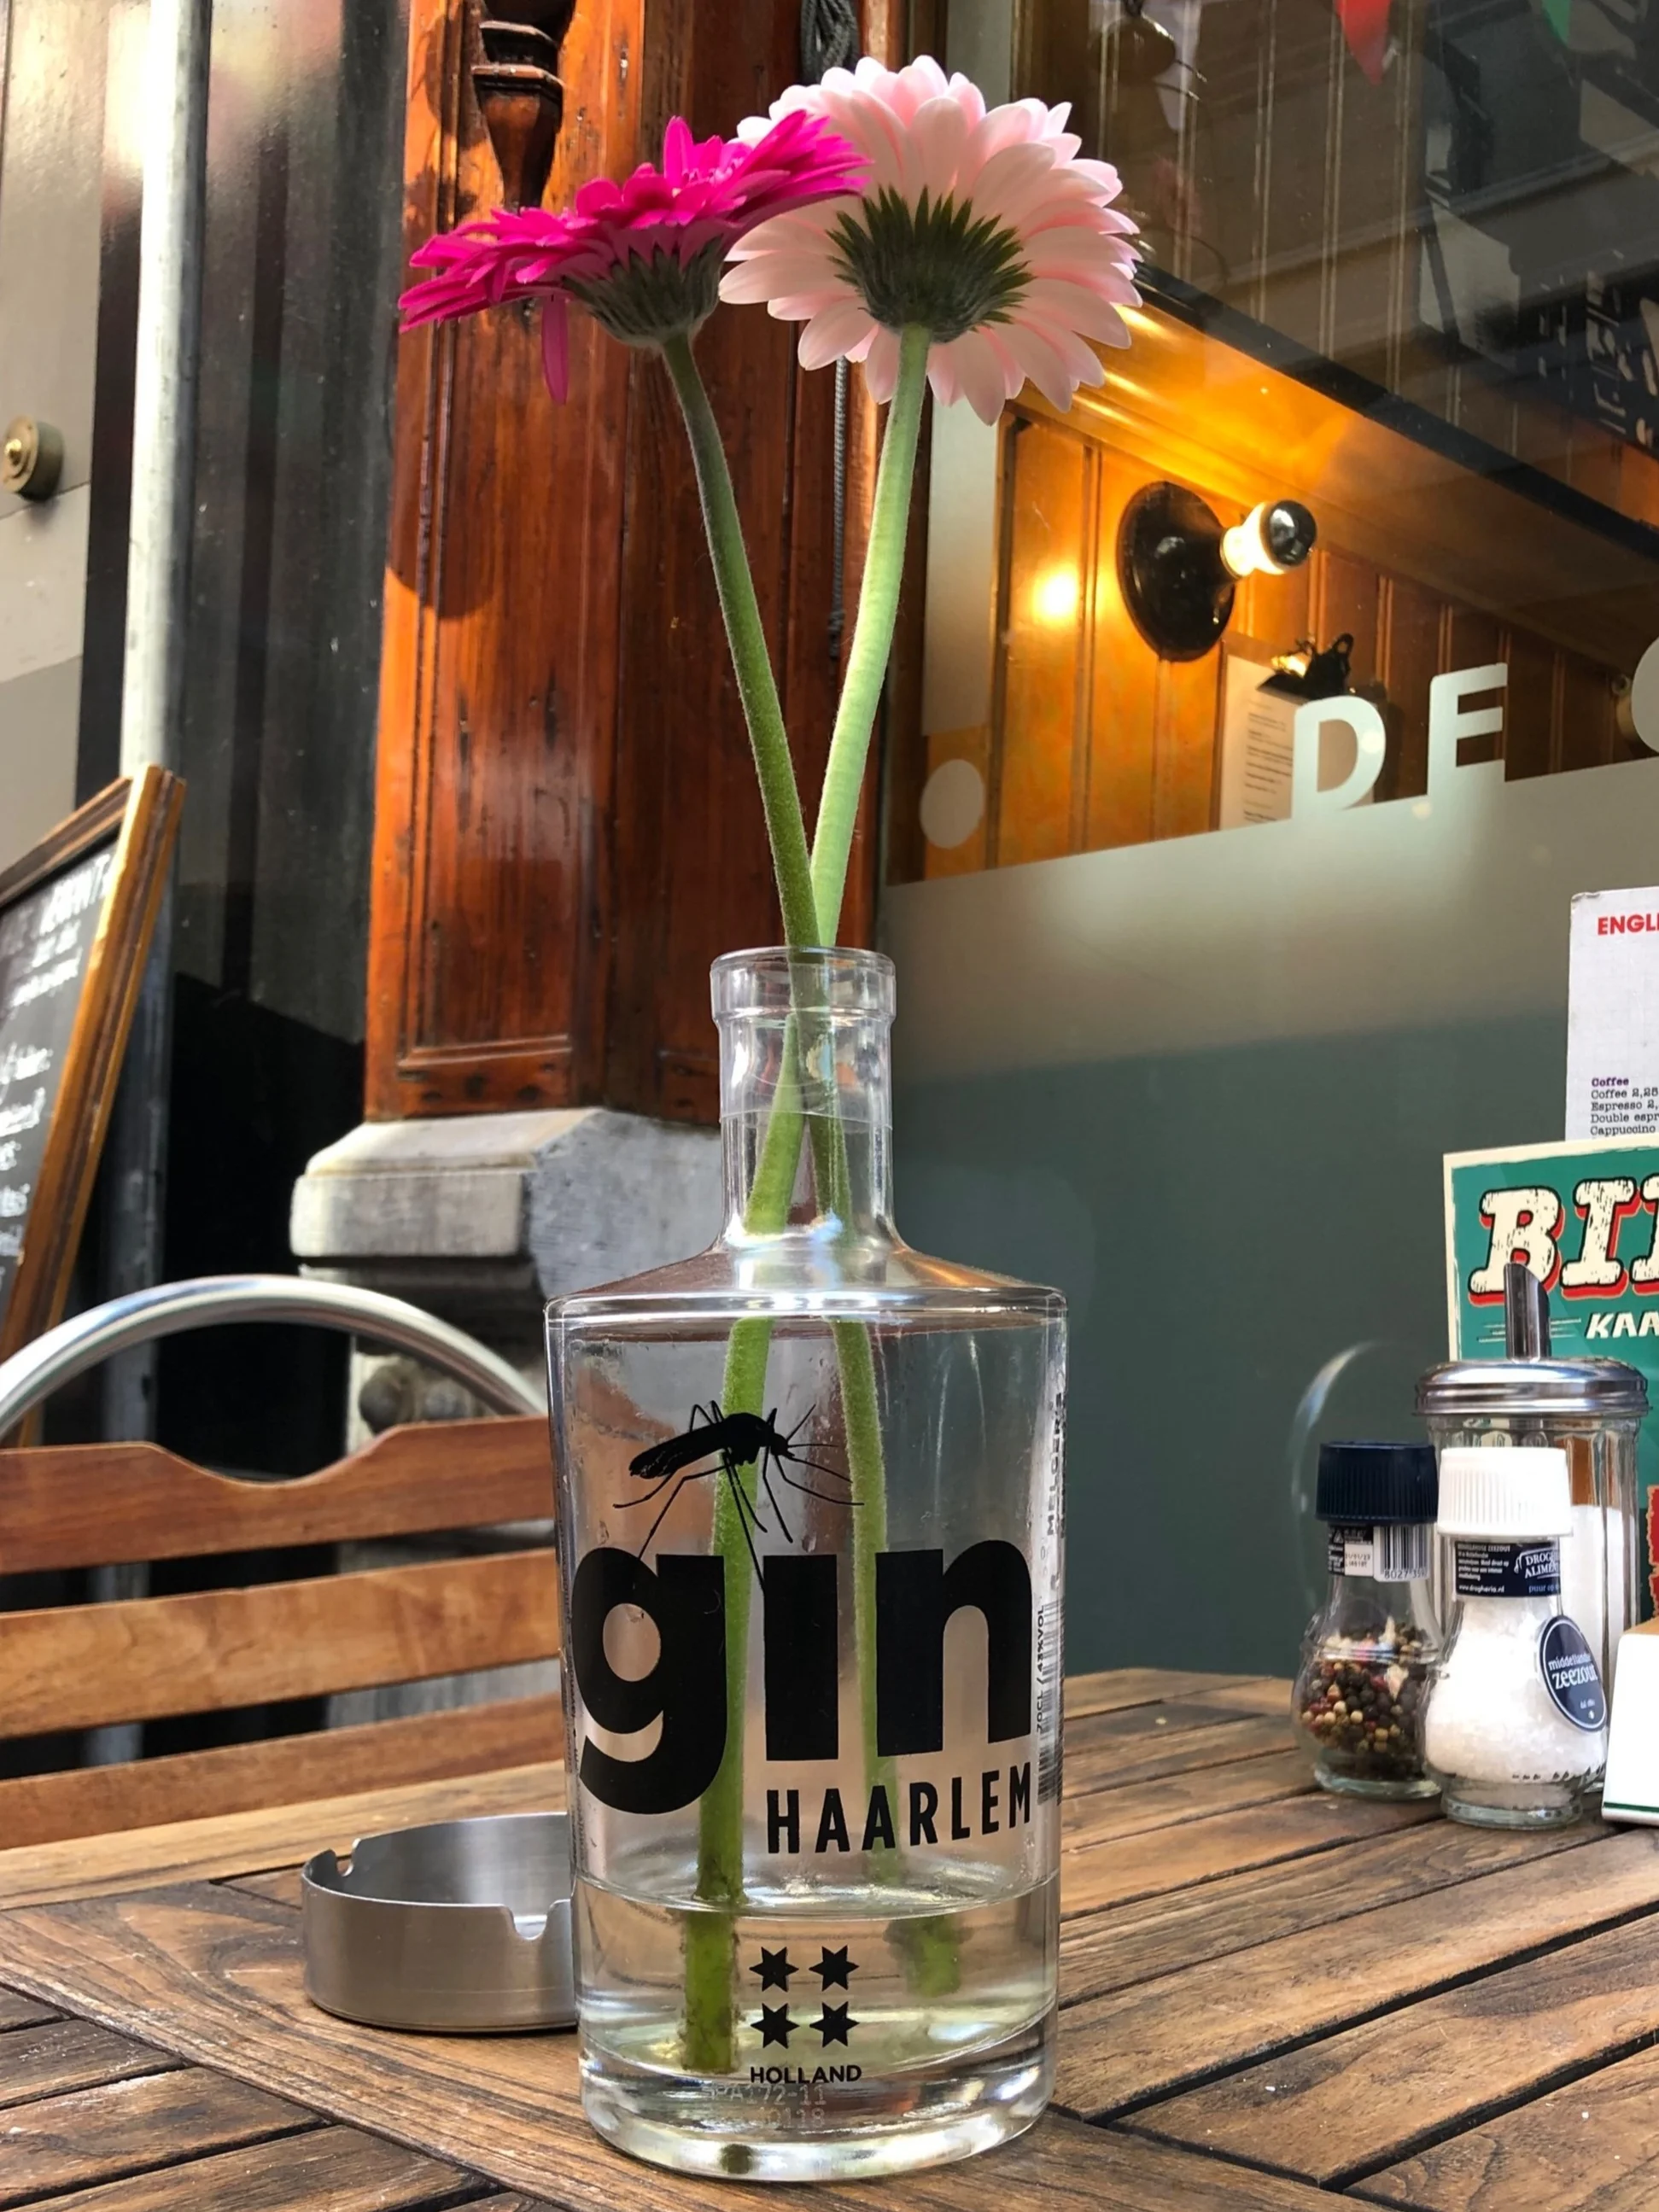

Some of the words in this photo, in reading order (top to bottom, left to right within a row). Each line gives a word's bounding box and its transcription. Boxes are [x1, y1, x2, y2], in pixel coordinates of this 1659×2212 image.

[1290, 662, 1508, 820] DE
[1592, 1077, 1629, 1087] Coffee
[1591, 1089, 1627, 1100] Coffee
[1632, 1087, 1658, 1099] 2,25
[1591, 1101, 1643, 1112] Espresso
[1590, 1113, 1630, 1124] Double
[1590, 1125, 1656, 1137] Cappuccino
[571, 1539, 1033, 1815] gin
[767, 1761, 1031, 1854] HAARLEM
[750, 2064, 862, 2085] HOLLAND
